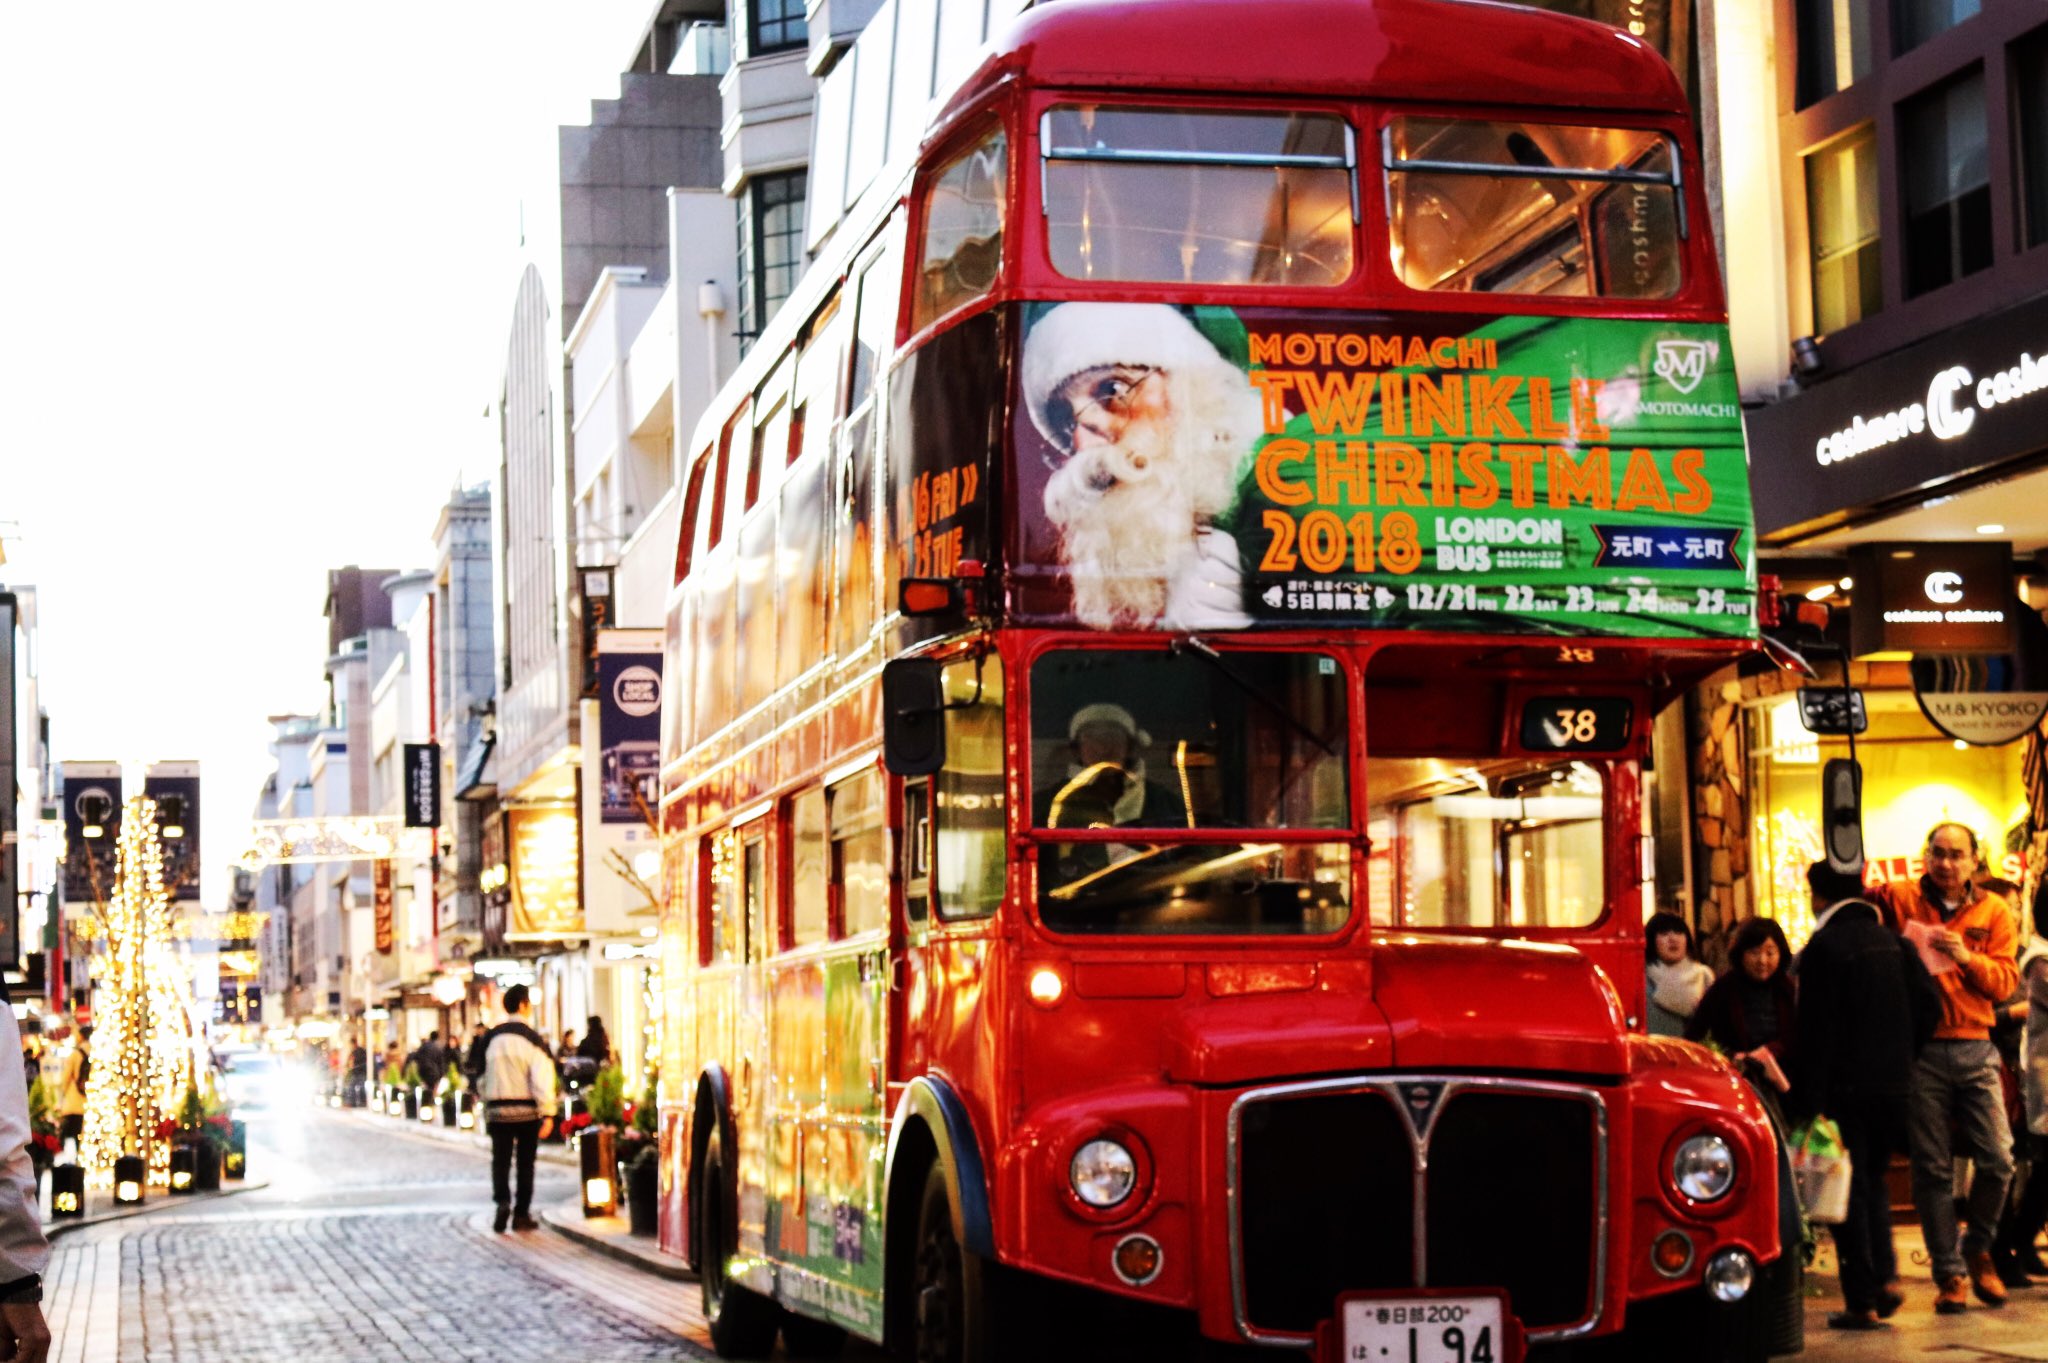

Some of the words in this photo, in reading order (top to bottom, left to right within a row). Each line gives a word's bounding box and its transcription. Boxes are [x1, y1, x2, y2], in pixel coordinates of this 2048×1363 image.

[1248, 333, 1498, 369] MOTOMACHI
[1249, 370, 1611, 441] TWINKLE
[1636, 402, 1736, 417] MOTOMACHI
[1255, 438, 1713, 514] CHRISTMAS
[1259, 510, 1422, 575] 2018
[1435, 516, 1562, 544] LONDON
[1436, 545, 1492, 572] BUS
[1611, 535, 1653, 557] 元町
[1684, 537, 1725, 559] 元町
[1406, 584, 1477, 611] 12/21
[1504, 585, 1535, 612] 22
[1565, 586, 1594, 612] 23
[1556, 708, 1597, 742] 38
[1865, 859, 1923, 889] ALE
[1377, 1306, 1464, 1324] 春日部200
[1353, 1345, 1367, 1360] は
